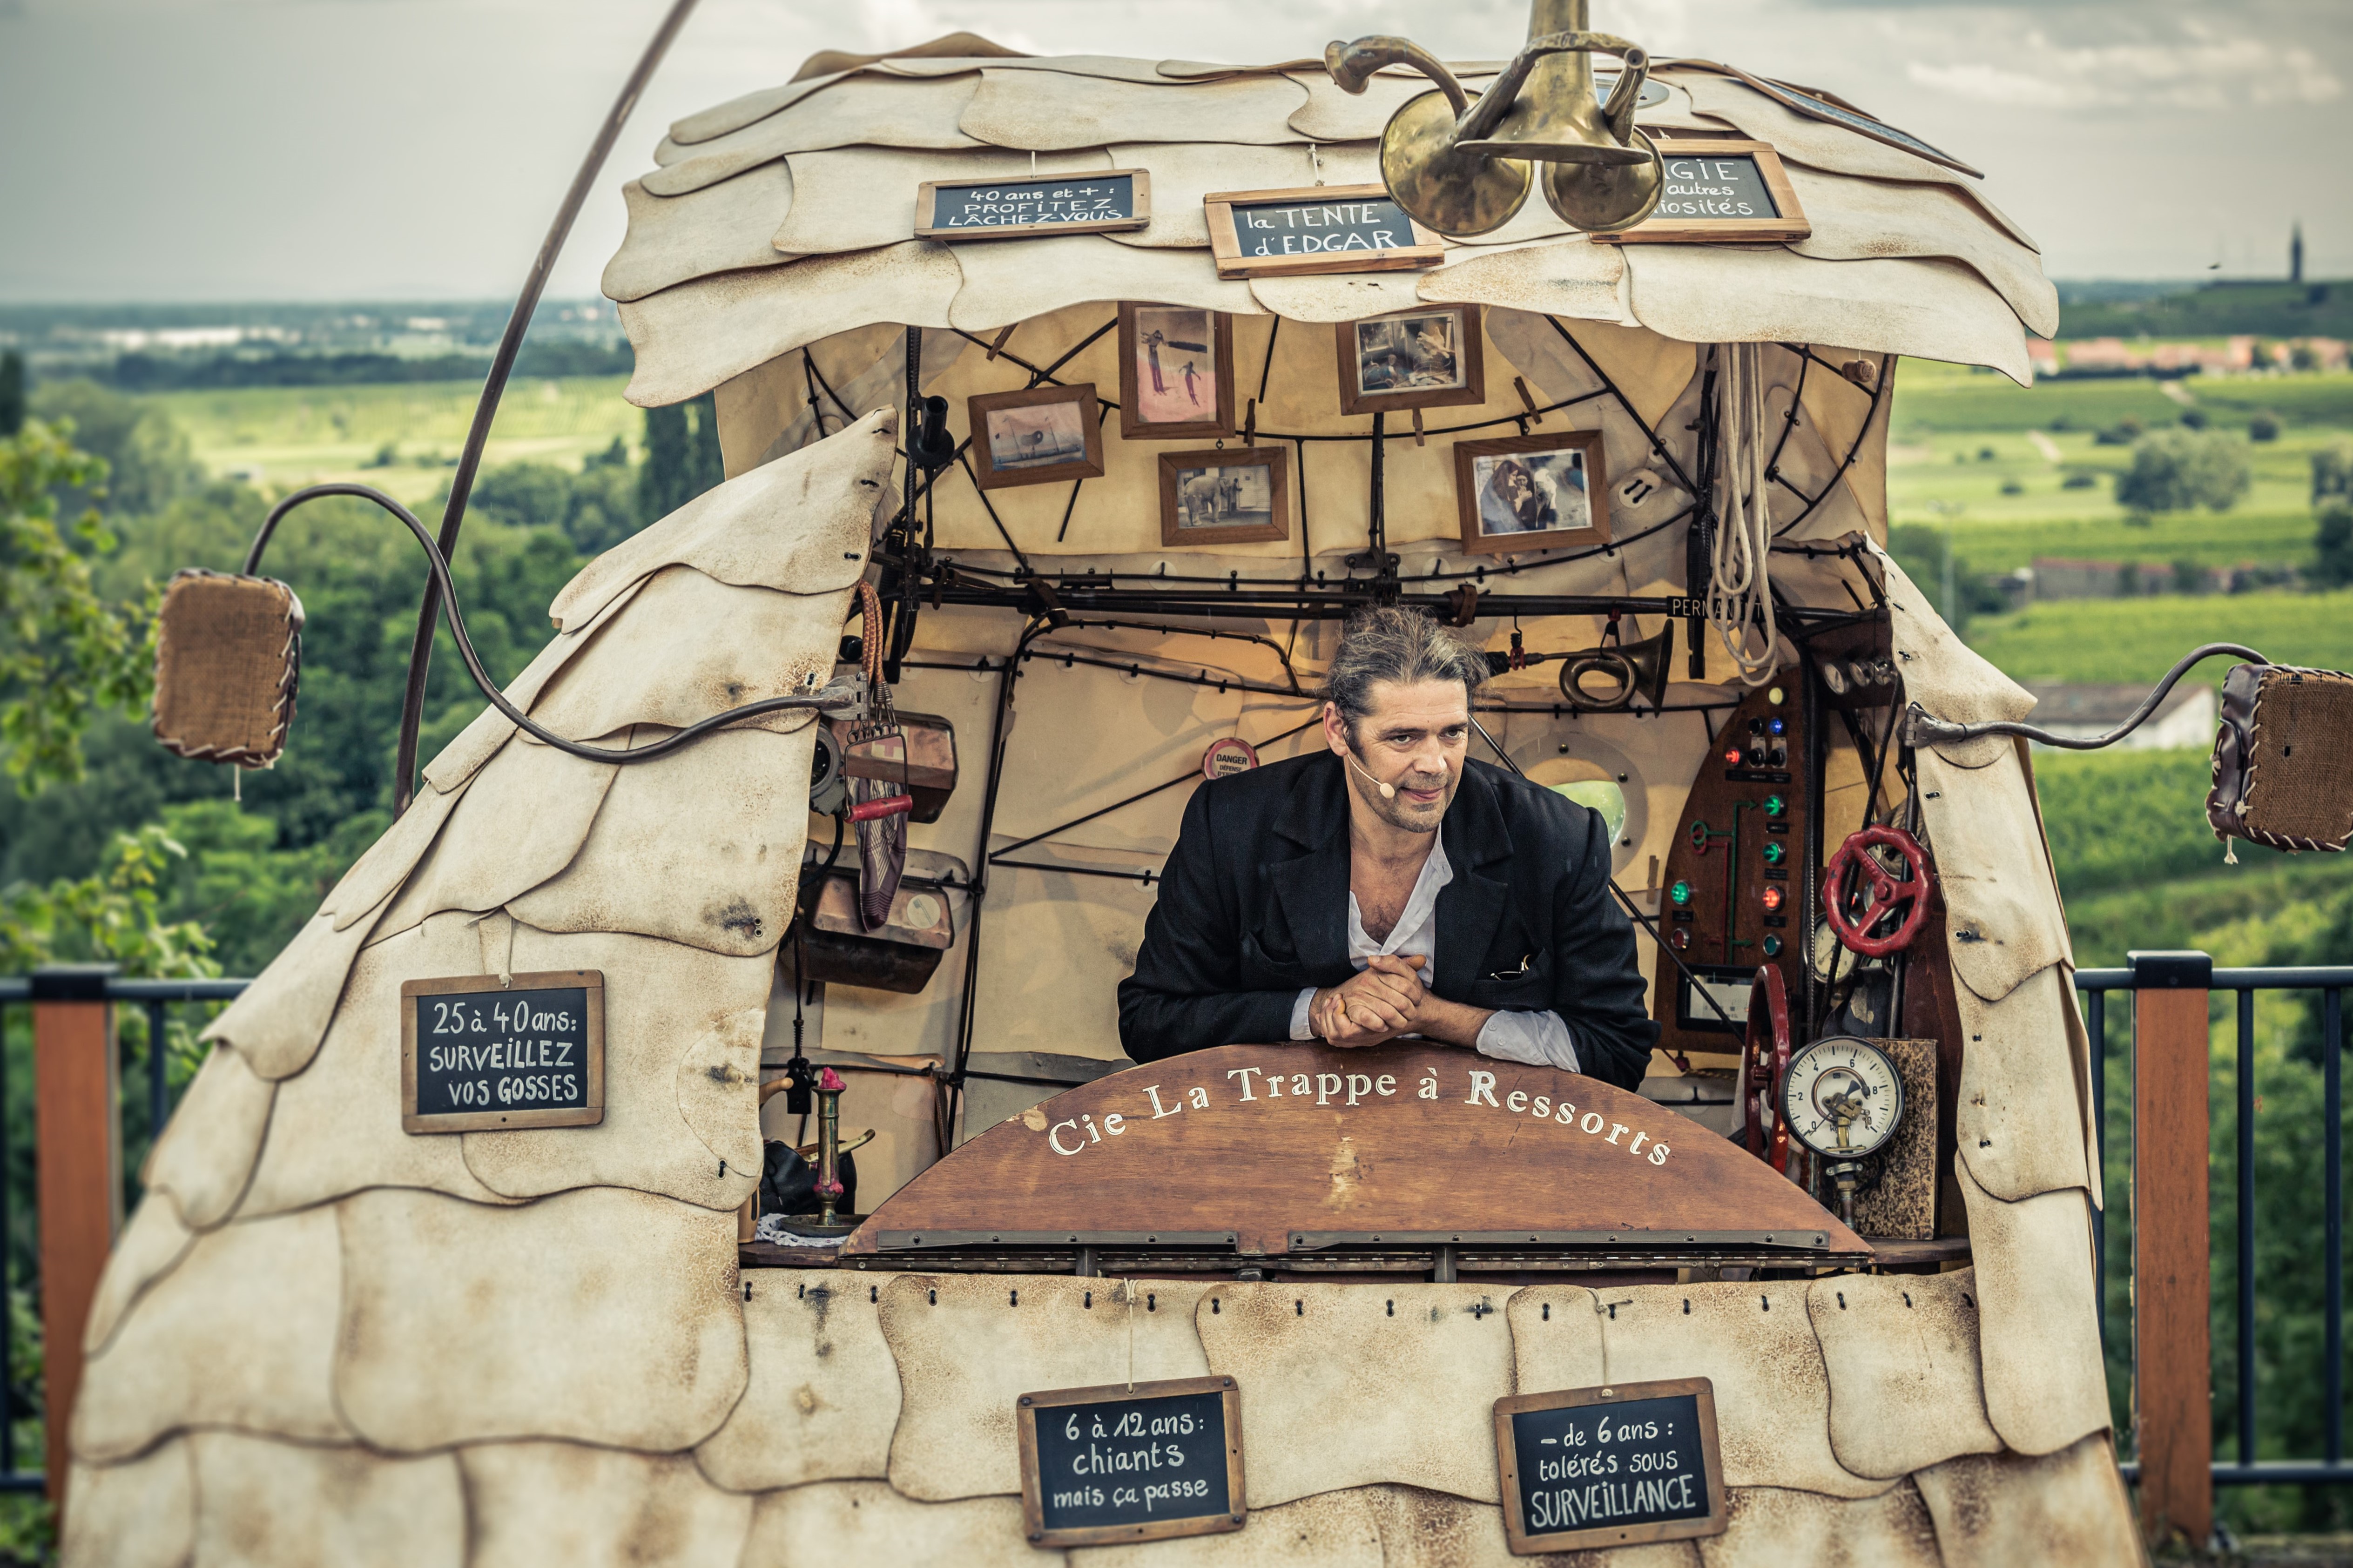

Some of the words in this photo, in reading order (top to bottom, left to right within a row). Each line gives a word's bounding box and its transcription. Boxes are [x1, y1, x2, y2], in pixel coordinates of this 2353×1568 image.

[1665, 159, 1738, 181] GIE
[971, 190, 999, 202] 40
[1005, 190, 1043, 201] ans
[1052, 188, 1073, 198] et
[1667, 182, 1734, 195] autres
[1246, 211, 1275, 229] la
[1275, 203, 1381, 228] TENTE
[1654, 198, 1753, 215] iosités
[1255, 230, 1400, 256] d'EDGAR
[1216, 754, 1247, 765] DANGER
[432, 1002, 466, 1034] 25
[471, 1009, 487, 1032] à
[493, 1001, 529, 1033] 40
[448, 1080, 490, 1106] VOS
[498, 1074, 578, 1105] GOSSES
[1049, 1112, 1126, 1156] Cie
[1142, 1084, 1210, 1120] La
[1227, 1067, 1396, 1106] Trappe
[1418, 1067, 1439, 1100] à
[1464, 1070, 1671, 1166] Ressorts
[1065, 1413, 1080, 1440] 6
[1092, 1414, 1107, 1438] à
[1114, 1412, 1146, 1437] 12
[1564, 1423, 1587, 1447] de
[1598, 1416, 1611, 1443] 6
[1073, 1441, 1185, 1475] chiants
[1540, 1450, 1618, 1481] tolérés
[1053, 1486, 1105, 1508] mais
[1112, 1487, 1139, 1507] ça
[1144, 1479, 1209, 1513] passe
